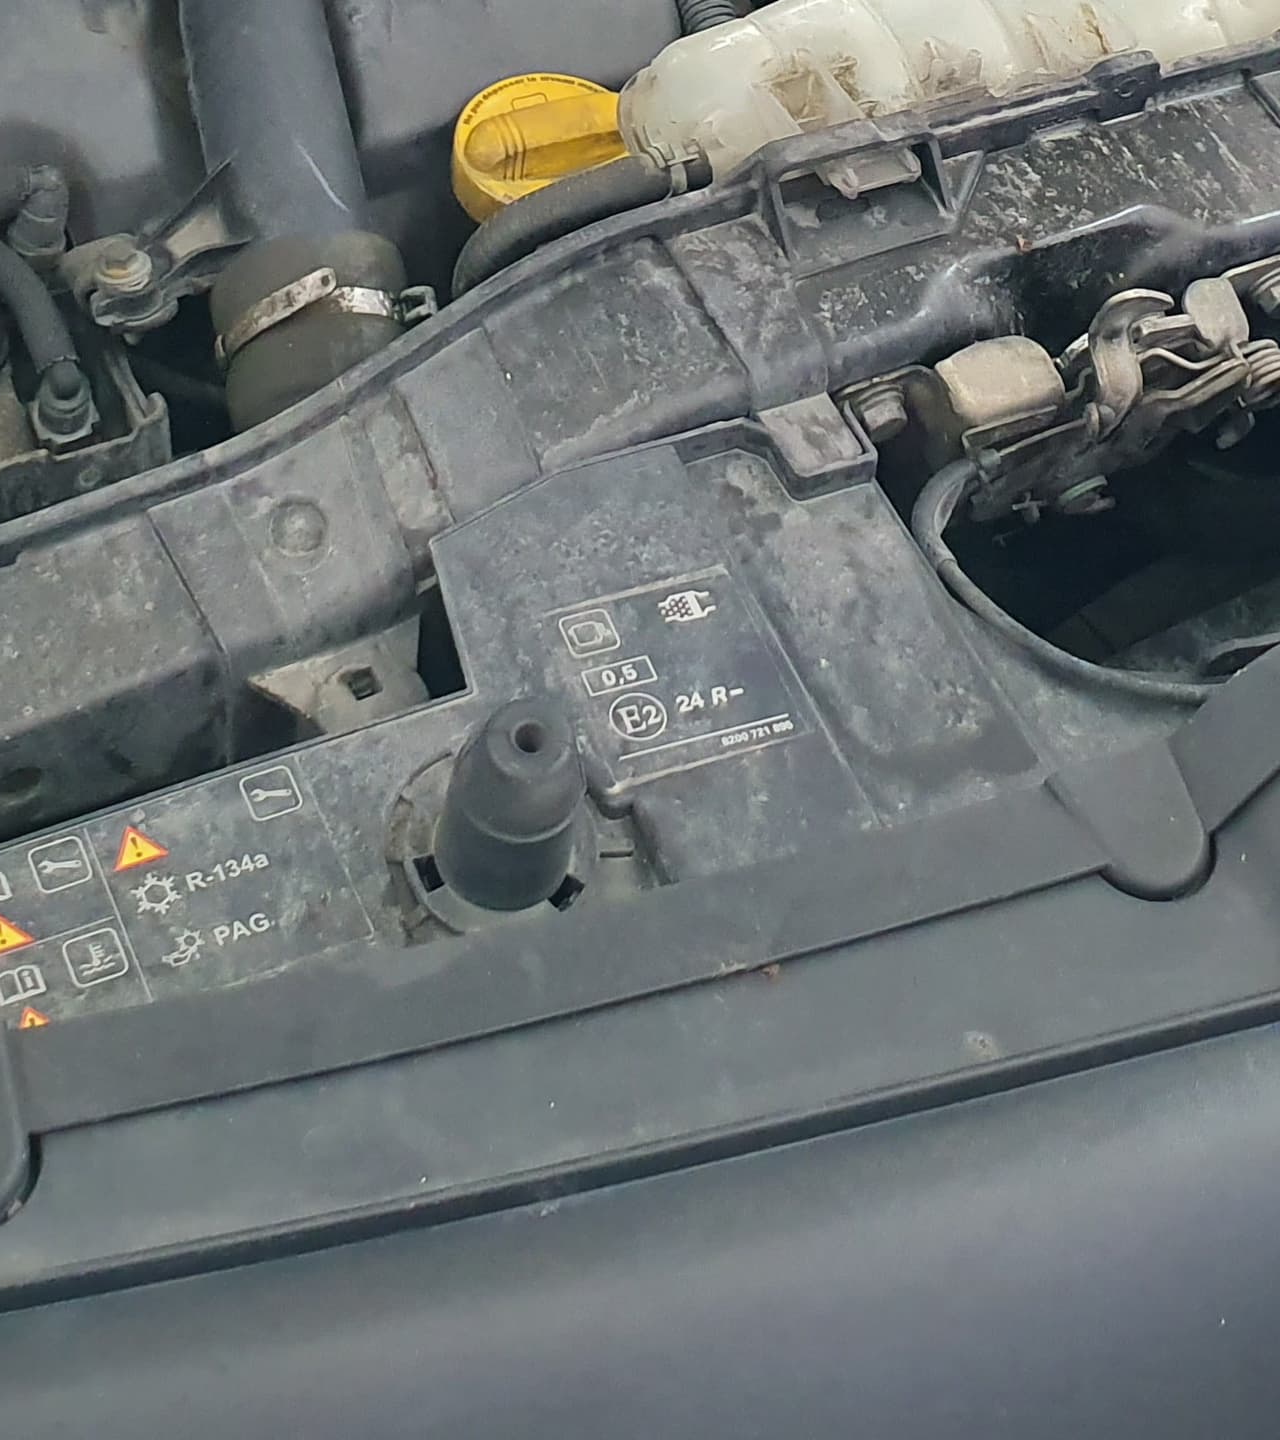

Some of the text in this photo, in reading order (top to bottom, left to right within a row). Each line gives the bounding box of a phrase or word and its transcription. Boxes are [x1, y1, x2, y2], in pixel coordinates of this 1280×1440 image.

[601, 664, 638, 687] 0,5
[617, 703, 663, 734] E2
[749, 725, 771, 739] 721
[185, 853, 270, 892] R-134a
